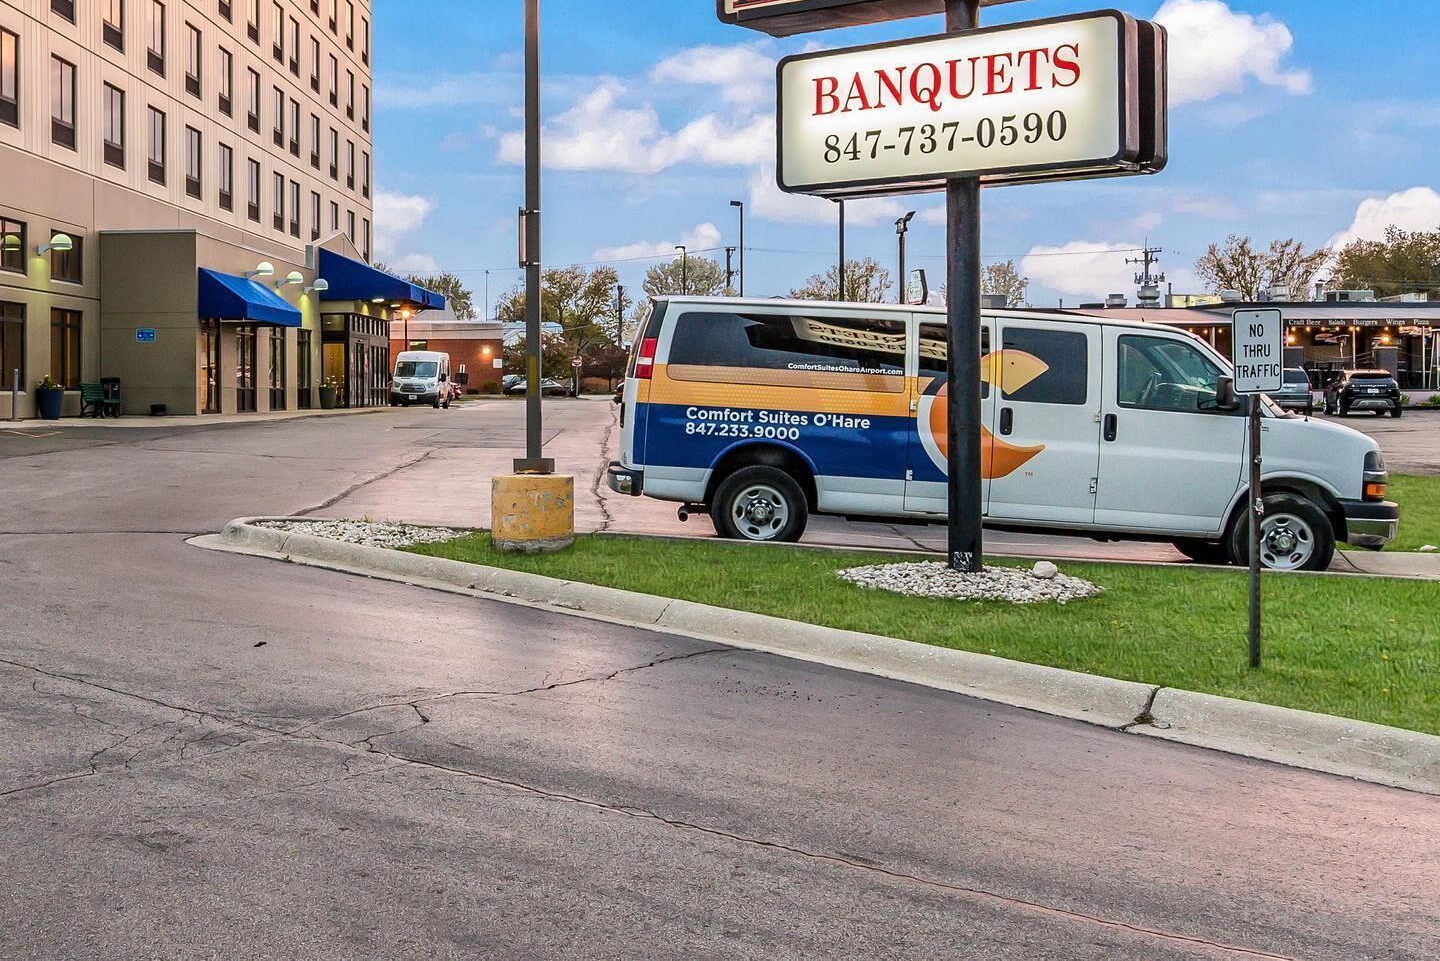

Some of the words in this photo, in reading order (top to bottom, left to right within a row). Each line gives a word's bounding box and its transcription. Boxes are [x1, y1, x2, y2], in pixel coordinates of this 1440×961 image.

[812, 43, 1081, 116] BANQUETS
[823, 110, 1067, 163] 847-737-0590
[1352, 319, 1378, 327] Burgers
[1249, 324, 1264, 337] NO
[1243, 344, 1271, 358] THRU
[788, 362, 903, 375] ComfortSuitesOhareAirport.com
[1236, 364, 1280, 378] TRAFFIC
[686, 407, 754, 423] Comfort
[758, 410, 808, 425] Suites
[685, 422, 800, 439] 847.233.9000
